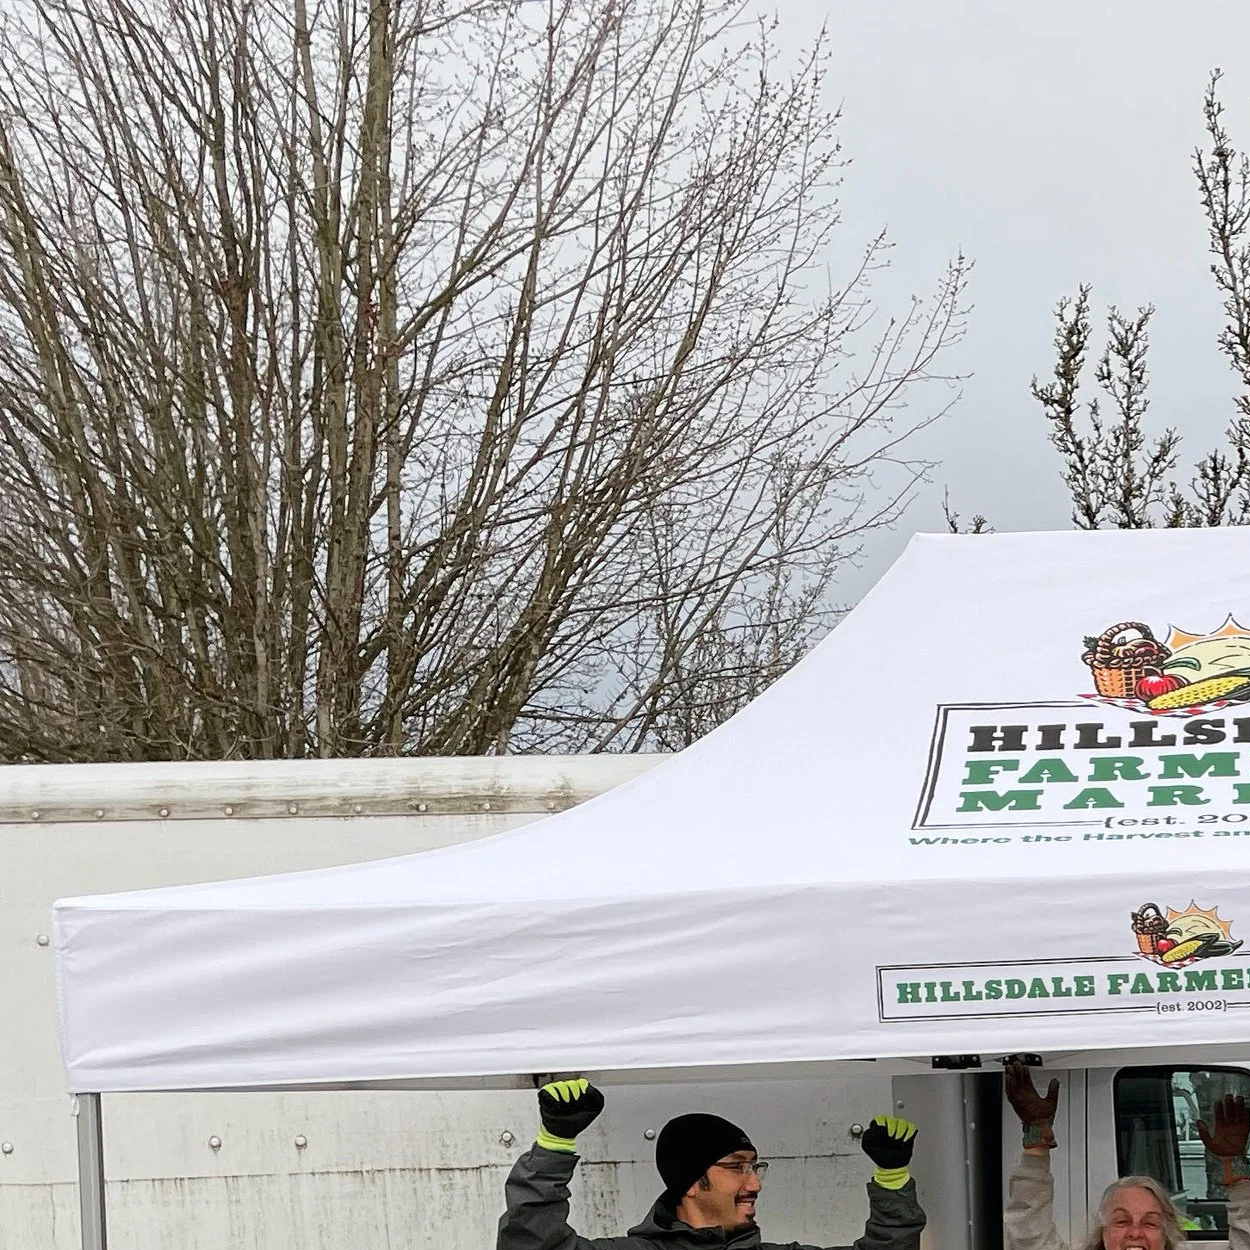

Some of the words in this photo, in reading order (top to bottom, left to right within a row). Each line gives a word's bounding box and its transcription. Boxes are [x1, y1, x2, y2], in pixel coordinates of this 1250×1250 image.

[908, 836, 1012, 846] Where
[1021, 834, 1073, 843] the
[1083, 830, 1204, 841] Harvest
[897, 976, 1094, 1004] HILLSDALE
